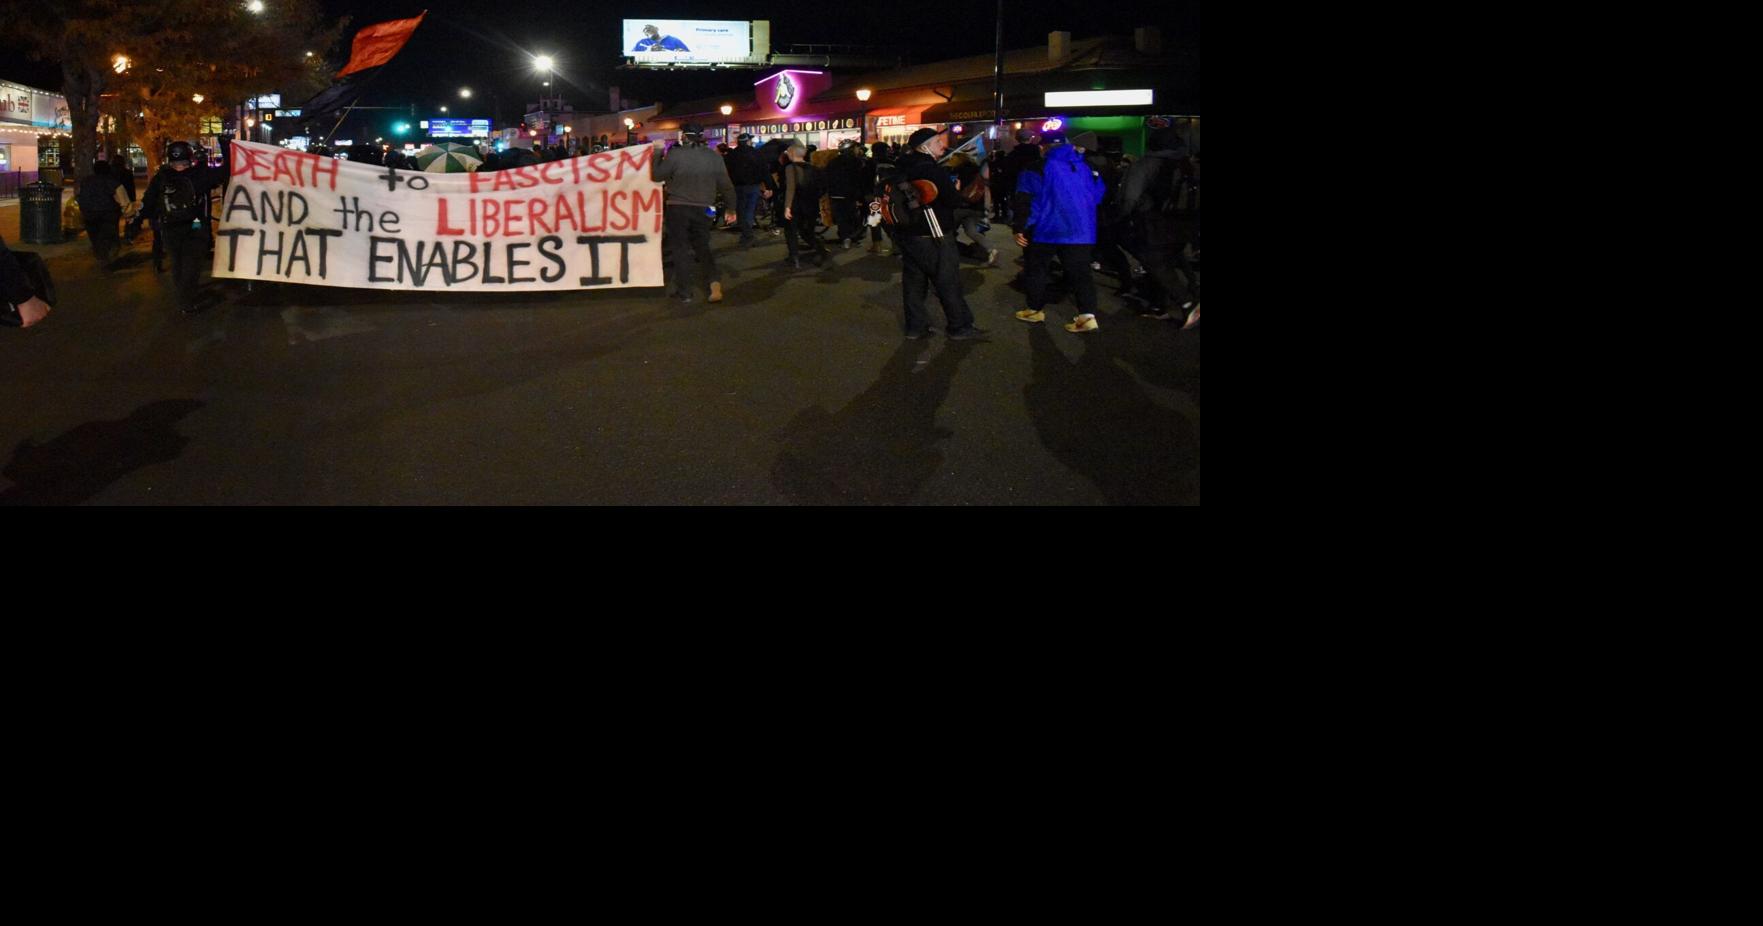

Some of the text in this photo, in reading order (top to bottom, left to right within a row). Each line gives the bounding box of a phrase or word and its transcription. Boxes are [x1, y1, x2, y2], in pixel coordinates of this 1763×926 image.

[230, 142, 654, 193] DEATH to FASCISM
[226, 184, 661, 238] AND the LIBERALISM
[217, 228, 647, 287] THAT ENABLES IT
